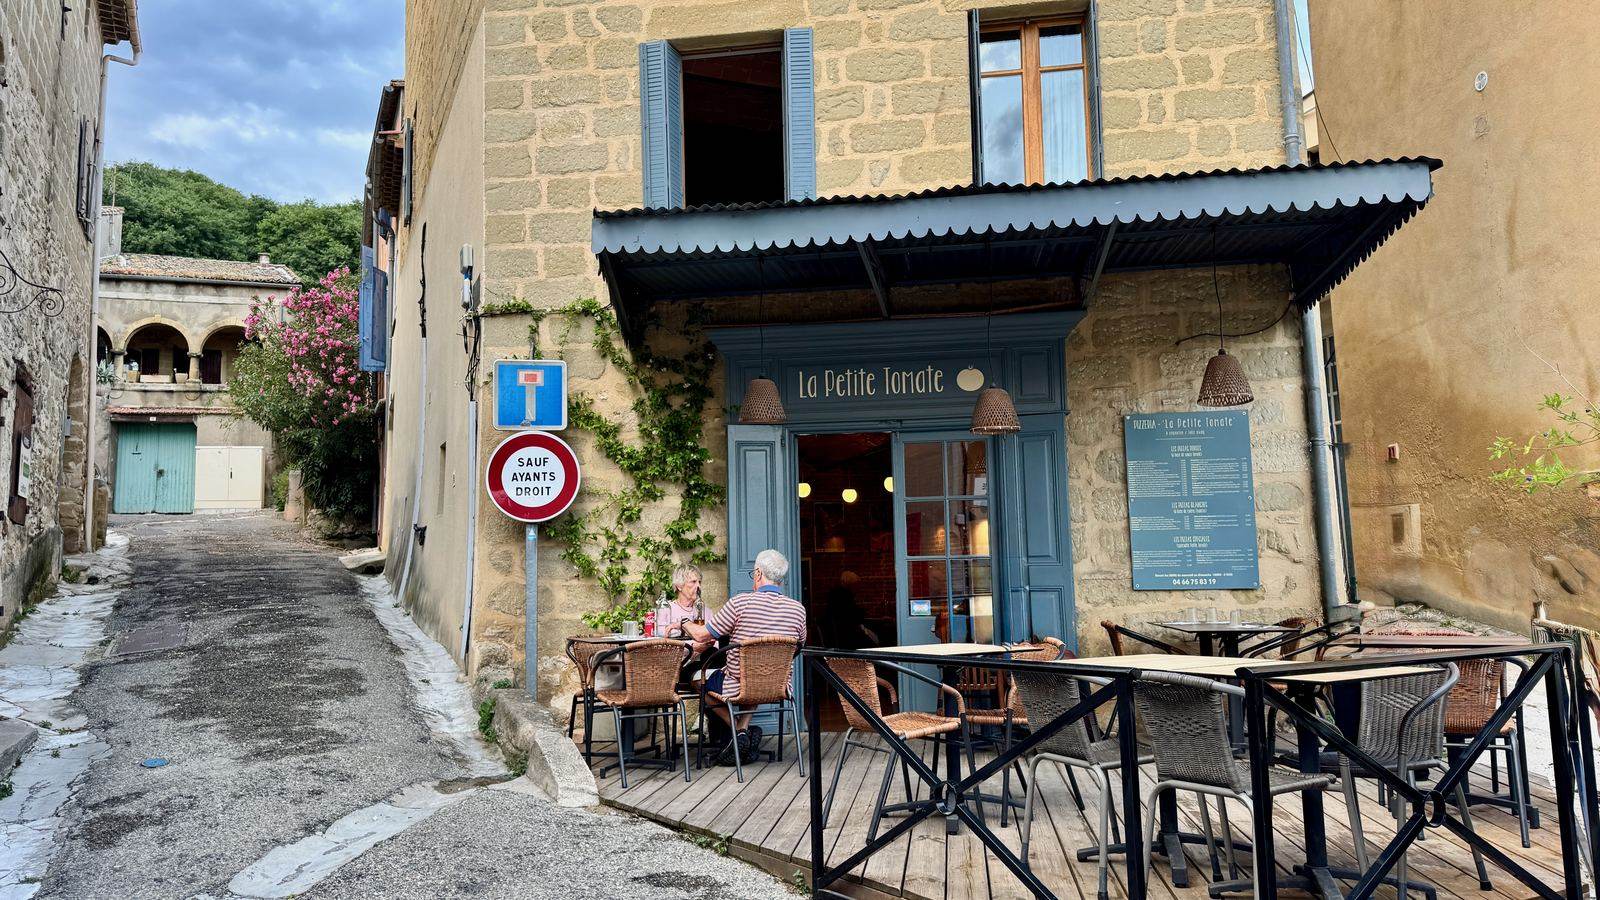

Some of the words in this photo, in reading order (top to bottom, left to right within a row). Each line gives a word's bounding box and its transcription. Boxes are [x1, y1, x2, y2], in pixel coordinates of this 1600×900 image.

[799, 371, 817, 398] La
[825, 368, 876, 397] Petite
[883, 365, 944, 394] Tomate
[517, 457, 549, 467] SAUF
[511, 472, 556, 482] AYANTS
[515, 486, 552, 496] DROIT
